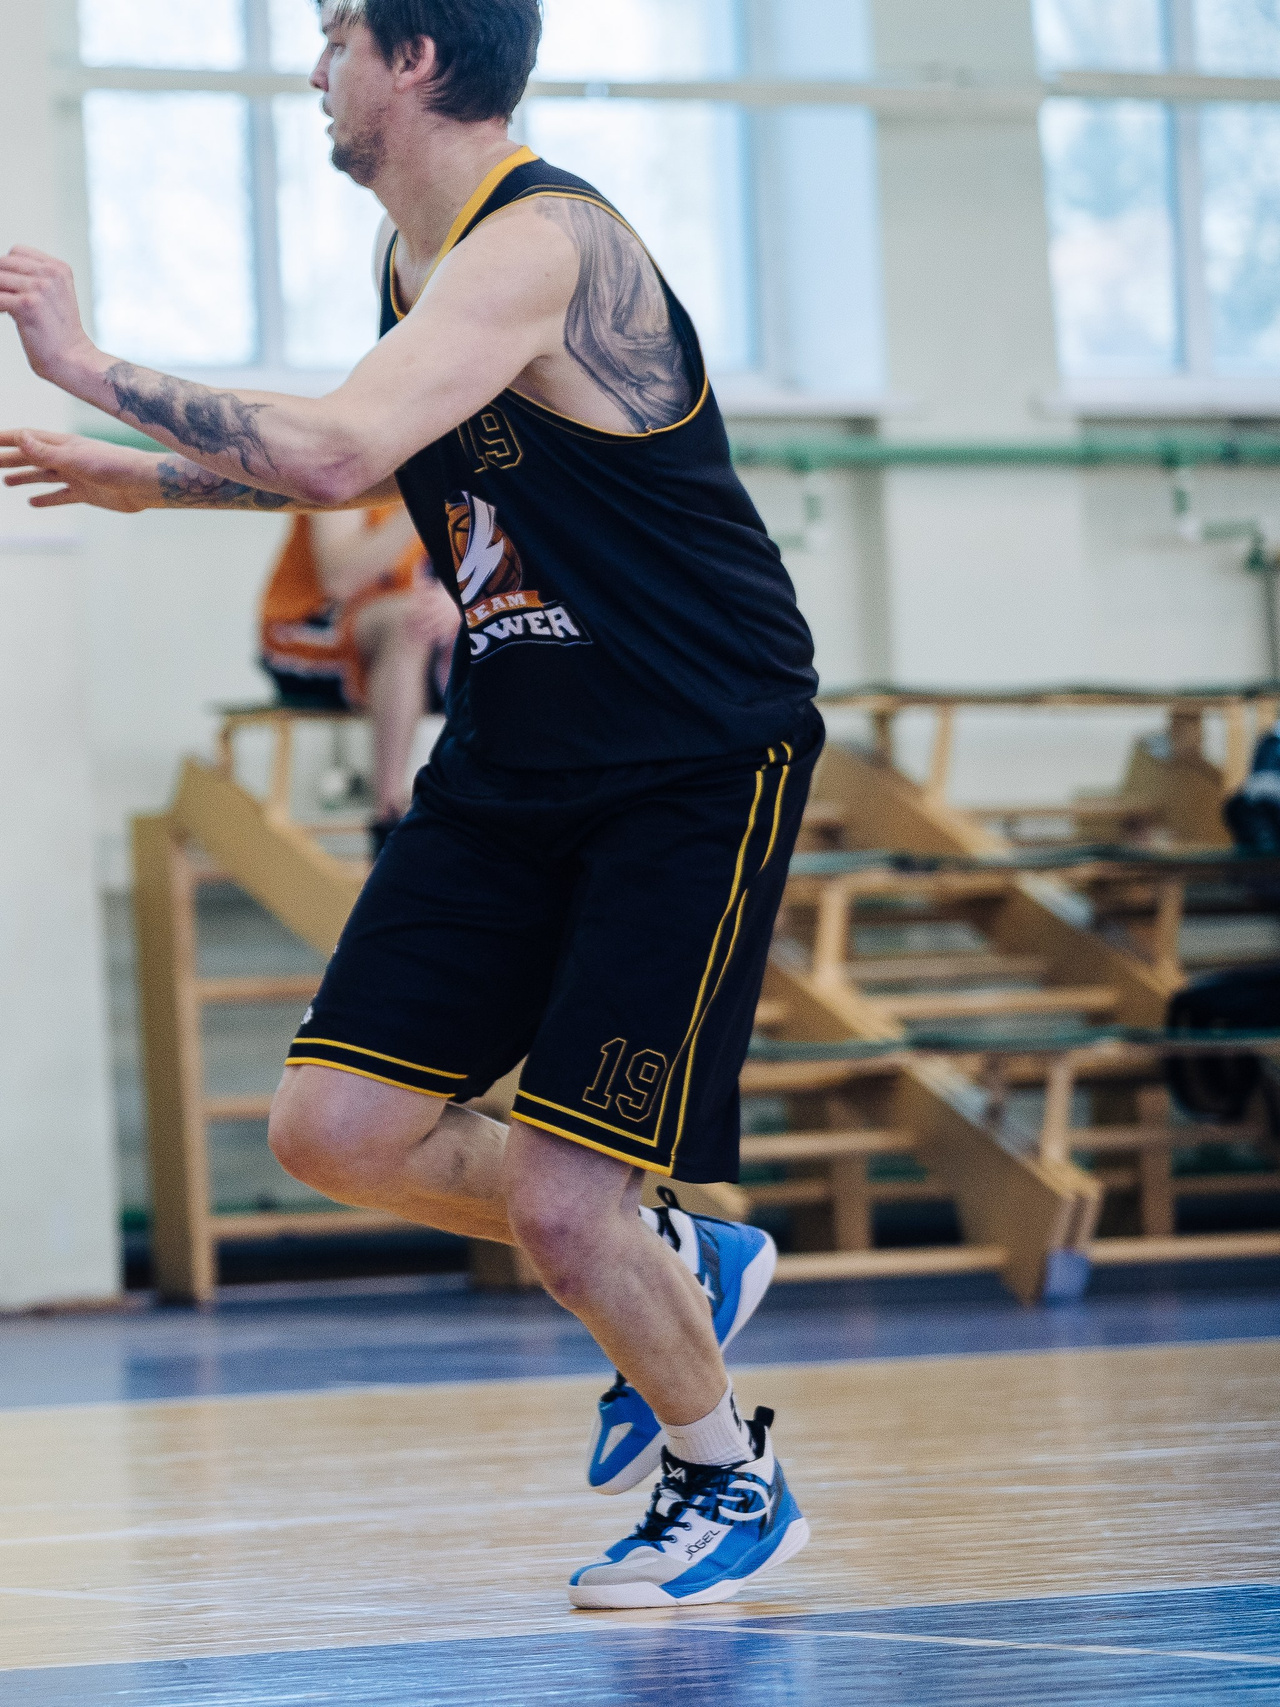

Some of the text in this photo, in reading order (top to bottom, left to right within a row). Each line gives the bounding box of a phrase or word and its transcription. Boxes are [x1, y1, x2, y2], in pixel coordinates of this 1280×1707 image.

[466, 592, 527, 627] EAM
[468, 605, 581, 656] OWER
[582, 1037, 668, 1122] 19
[684, 1529, 721, 1561] JÖGEL
